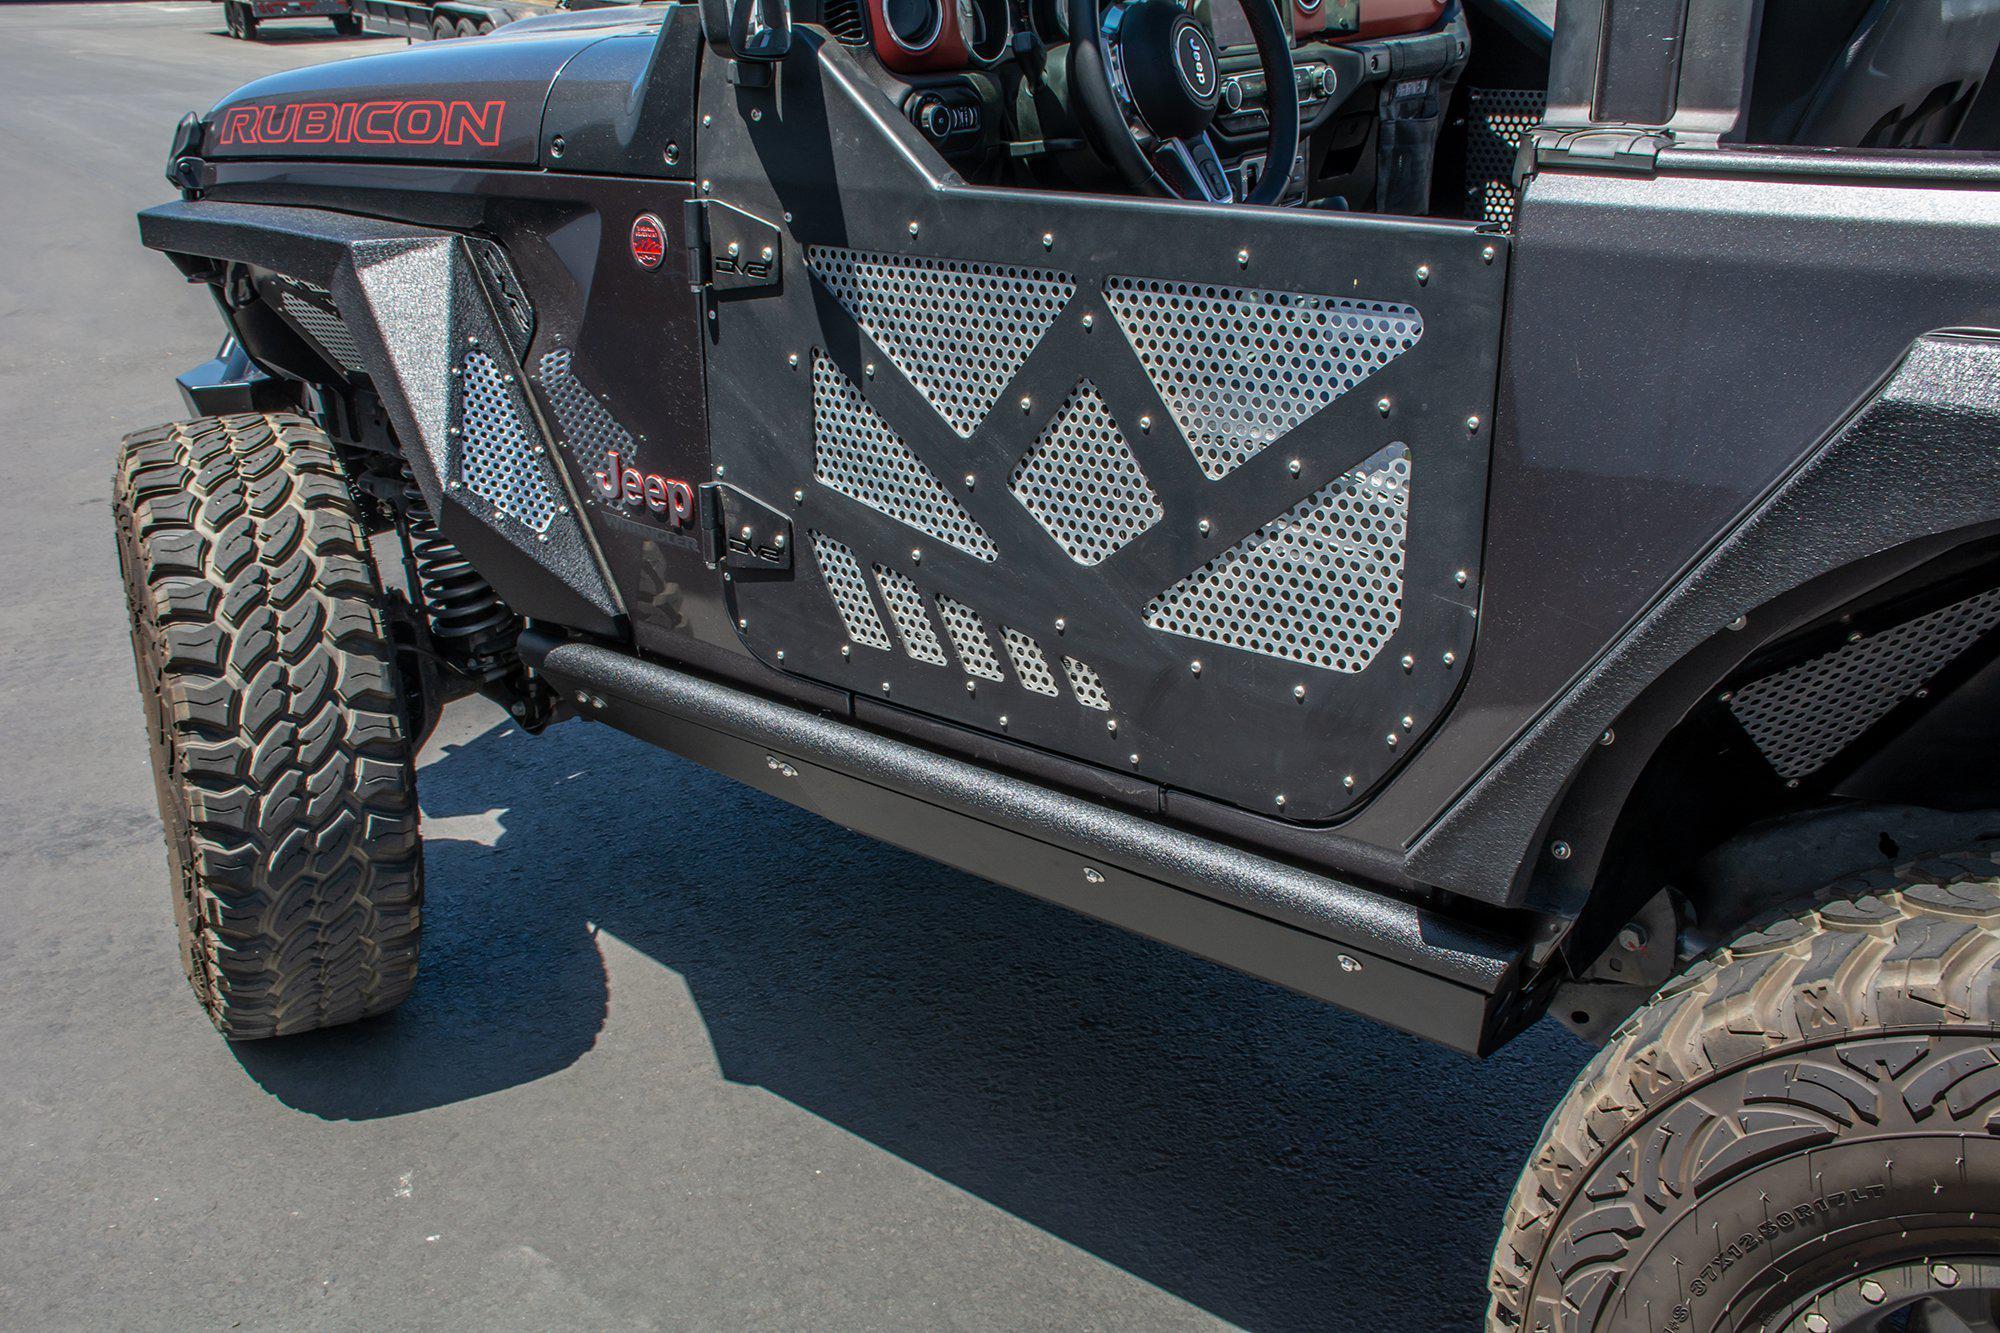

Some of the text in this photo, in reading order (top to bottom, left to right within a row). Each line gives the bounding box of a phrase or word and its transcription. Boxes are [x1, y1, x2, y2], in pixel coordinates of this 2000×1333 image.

[1189, 38, 1206, 85] Jeep
[220, 100, 506, 147] RUBICON
[595, 450, 695, 529] Jeep
